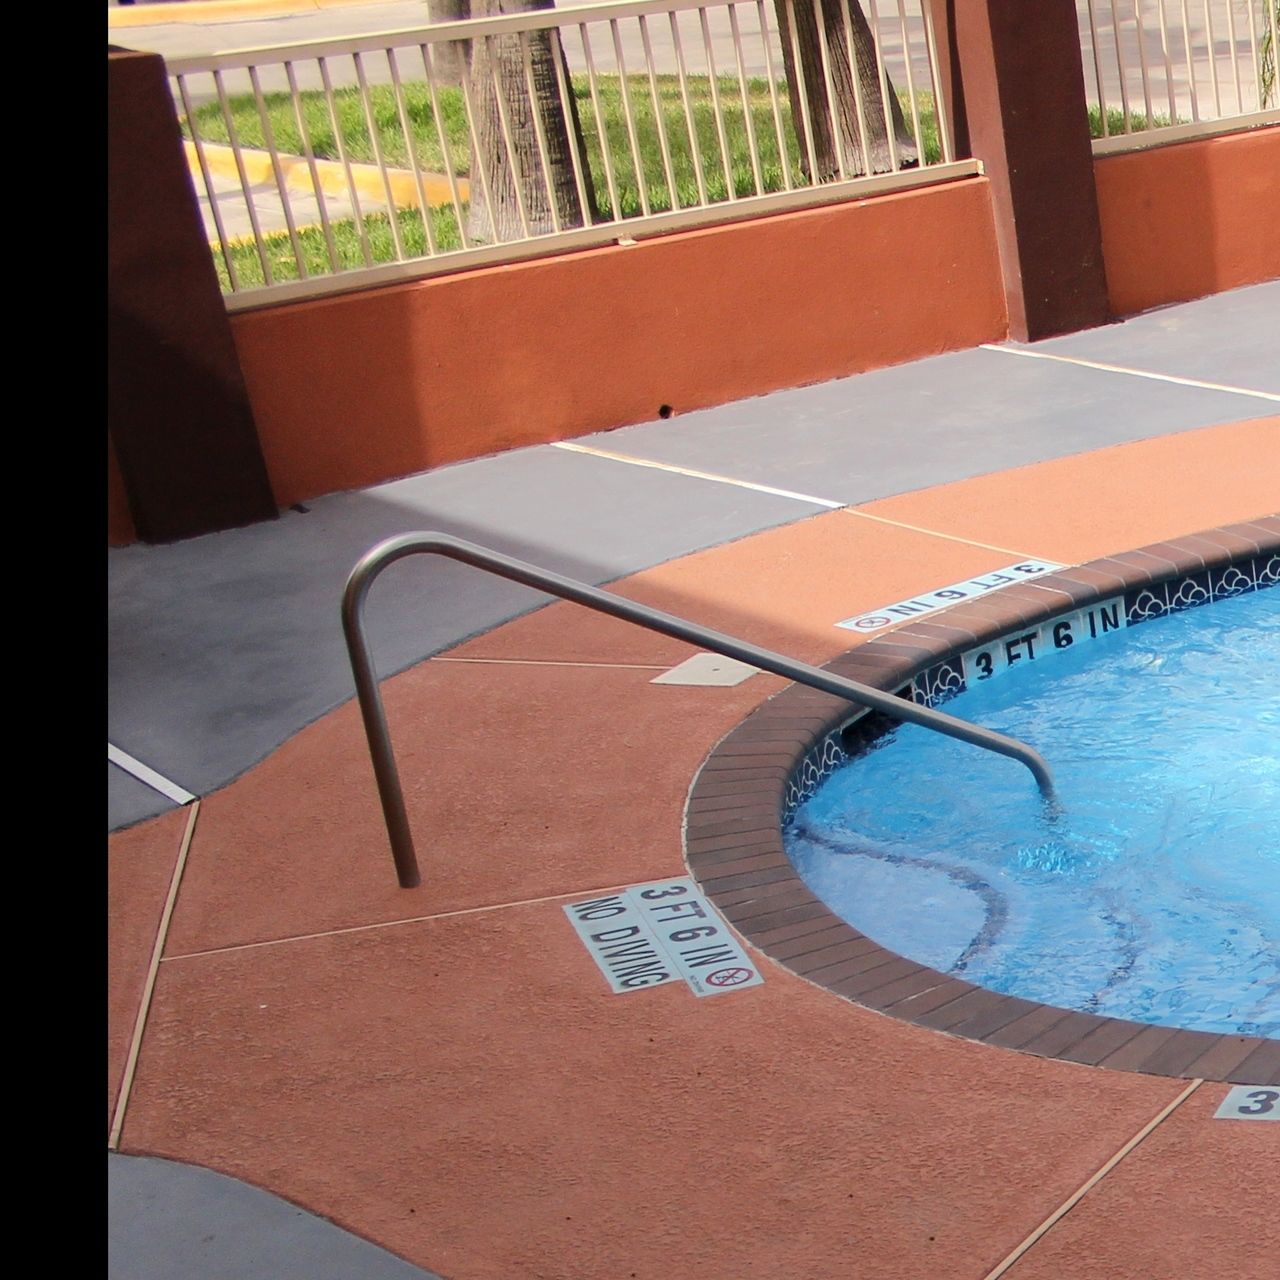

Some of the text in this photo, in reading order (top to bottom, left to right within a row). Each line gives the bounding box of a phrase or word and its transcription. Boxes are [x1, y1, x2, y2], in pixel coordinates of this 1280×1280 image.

[888, 564, 1044, 616] 3 FT 6 IN
[976, 603, 1120, 680] 3 FT 6 IN
[571, 896, 670, 987] NO DIVING
[641, 886, 738, 968] 3 FT 6 IN
[1237, 1091, 1280, 1115] 3
